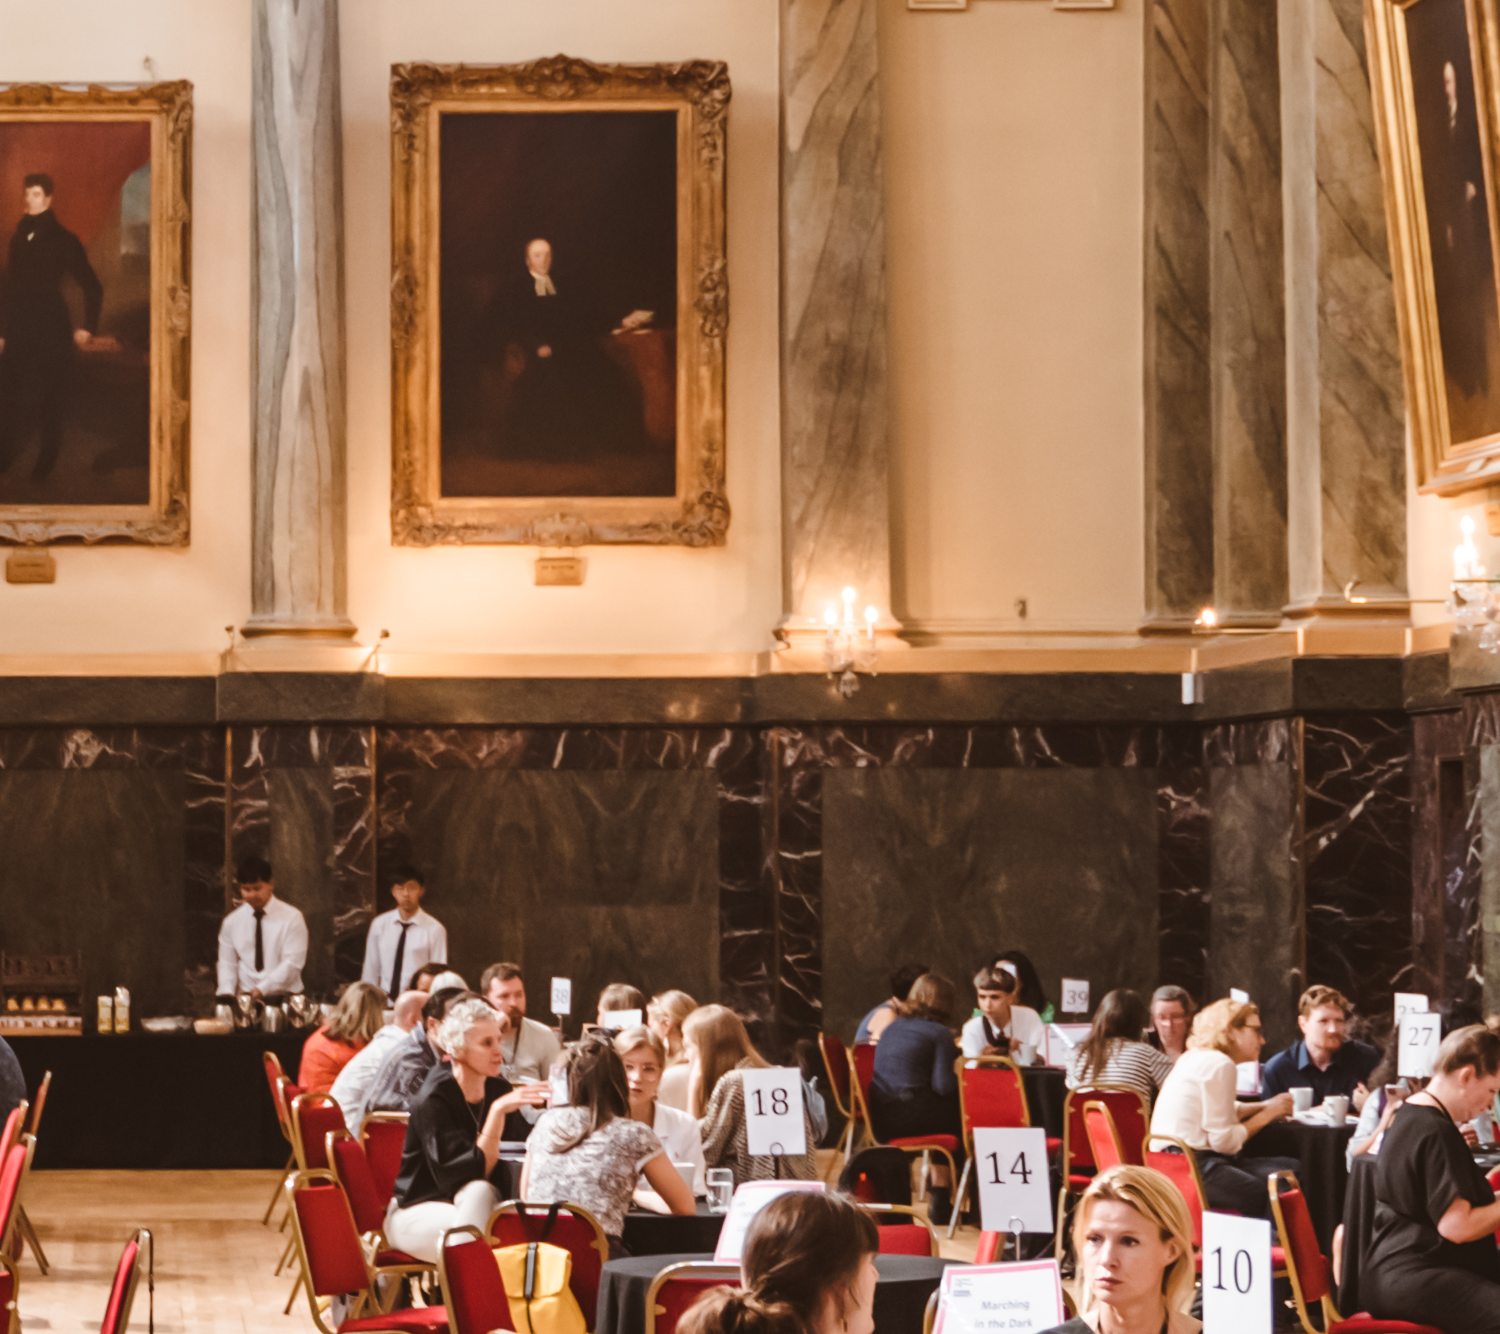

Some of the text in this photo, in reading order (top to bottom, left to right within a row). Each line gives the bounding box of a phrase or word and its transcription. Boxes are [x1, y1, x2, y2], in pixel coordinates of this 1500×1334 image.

[1066, 989, 1088, 1006] 39
[1408, 1026, 1434, 1046] 27
[751, 1087, 789, 1117] 18
[984, 1150, 1033, 1186] 14
[1210, 1245, 1253, 1295] 10
[980, 1300, 1030, 1311] Marching
[974, 1318, 1033, 1328] in the Dark
